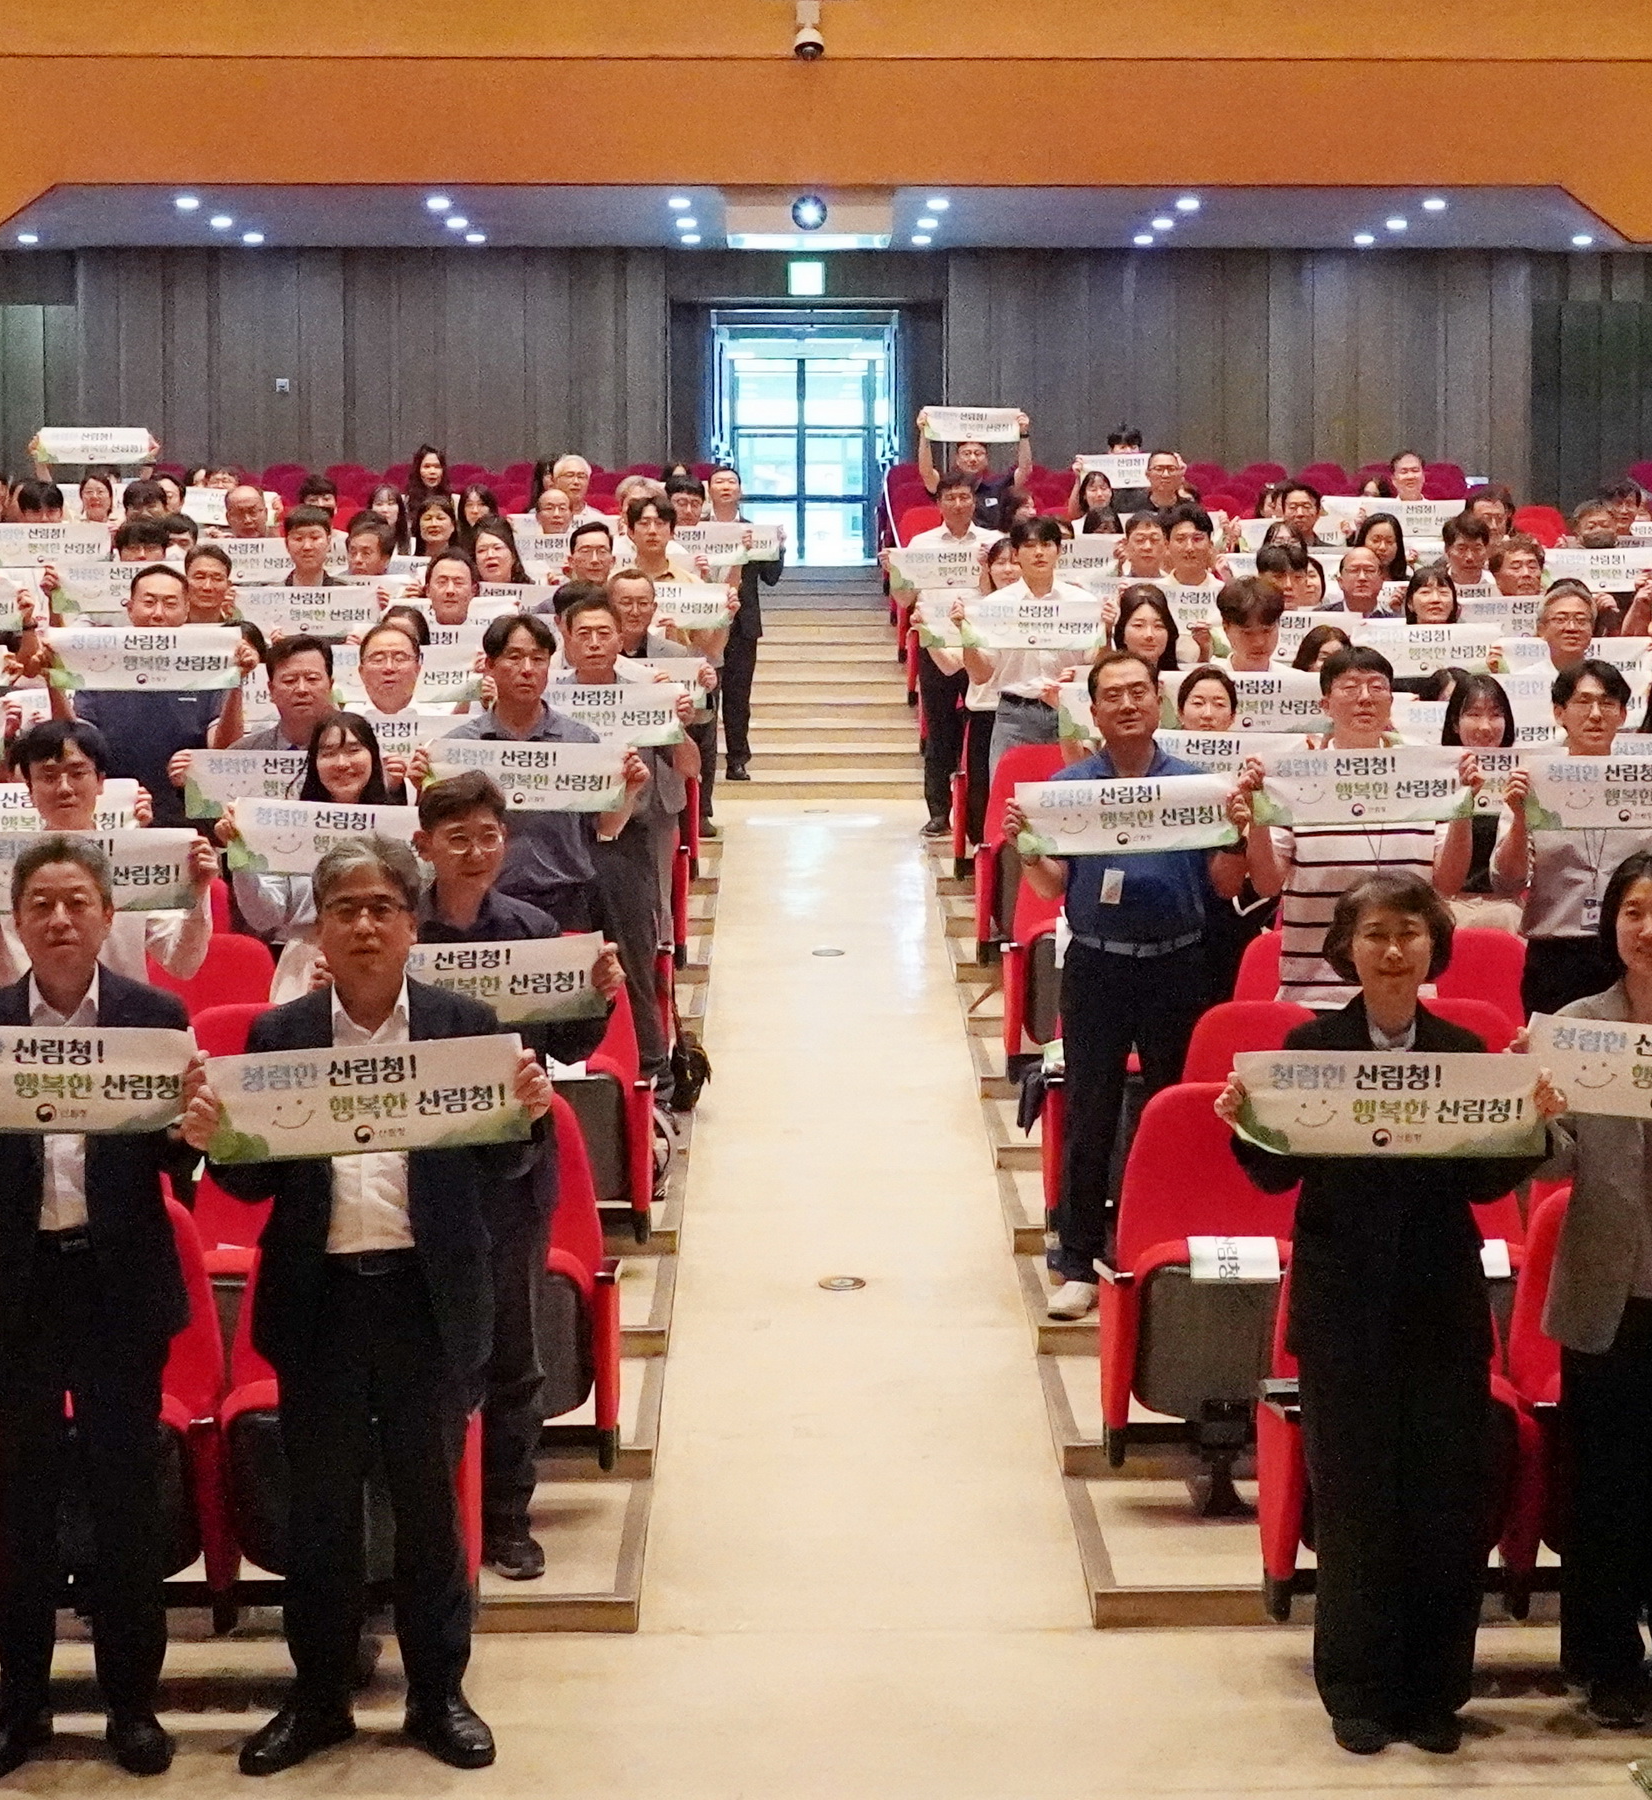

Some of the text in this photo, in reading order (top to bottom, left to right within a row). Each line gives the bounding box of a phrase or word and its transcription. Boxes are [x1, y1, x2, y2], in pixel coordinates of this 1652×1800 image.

[28, 528, 66, 539] 산림청!
[937, 550, 972, 564] 산림청!
[1589, 554, 1626, 565] 산림청!
[290, 592, 331, 605] 산림청!
[680, 601, 719, 614] 산림청!
[330, 608, 370, 621] 산림청!
[1018, 604, 1060, 618] 산림청!
[1057, 620, 1099, 633] 산림청!
[124, 635, 177, 649] 산림청!
[1408, 629, 1451, 643] 산림청!
[174, 656, 229, 670] 산림청!
[571, 689, 623, 705] 산림청!
[621, 709, 673, 725] 산림청!
[1185, 737, 1240, 756] 산림청!
[501, 750, 556, 768] 산림청!
[1334, 757, 1396, 776] 산림청!
[555, 773, 610, 791] 산림청!
[1335, 779, 1455, 799] 행복한 산림청!
[1099, 784, 1161, 805] 산림청!
[313, 810, 375, 830] 산림청!
[1099, 806, 1223, 827] 행복한 산림청!
[113, 864, 180, 885] 산림청!
[434, 947, 511, 968] 산림청!
[508, 970, 585, 994] 산림청!
[12, 1038, 104, 1066] 산림청!
[327, 1055, 417, 1087] 산림청!
[1354, 1065, 1443, 1090] 산림청!
[14, 1074, 182, 1100] 행복한 산림청
[330, 1084, 506, 1122] 행복한 산림청!
[1352, 1098, 1522, 1124] 행복한 산림청!
